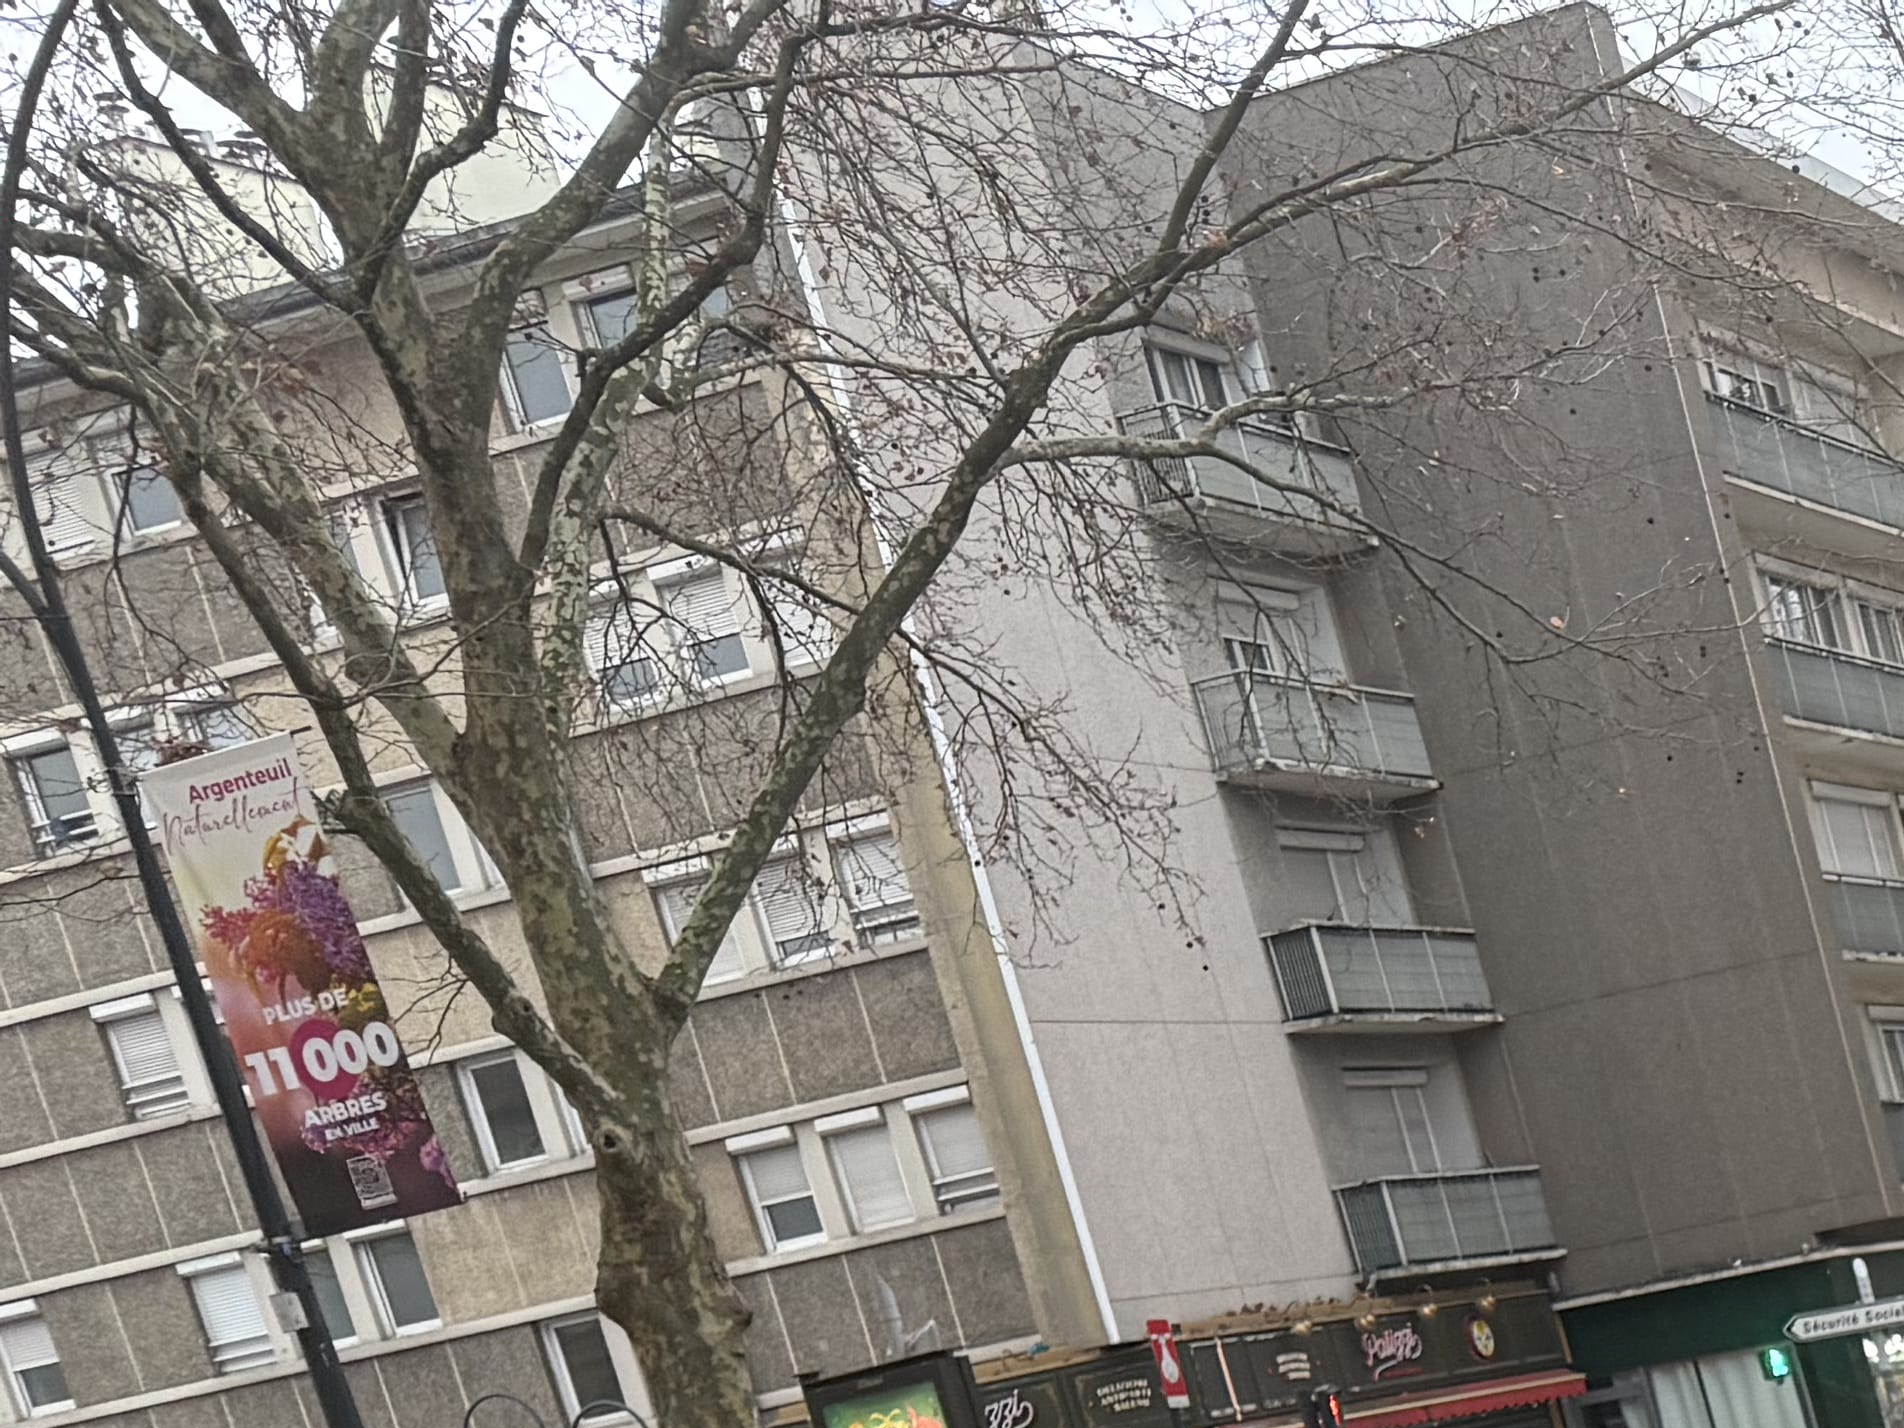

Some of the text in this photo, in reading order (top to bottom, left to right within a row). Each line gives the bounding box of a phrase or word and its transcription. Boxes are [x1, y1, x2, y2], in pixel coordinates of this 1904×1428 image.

[189, 757, 292, 803] Argenteuil
[262, 987, 350, 1026] PLUS DE
[244, 1020, 400, 1096] 11 000
[304, 1091, 388, 1128] ARBRES
[345, 1117, 381, 1136] VILLE
[1802, 1313, 1861, 1335] Sécurité
